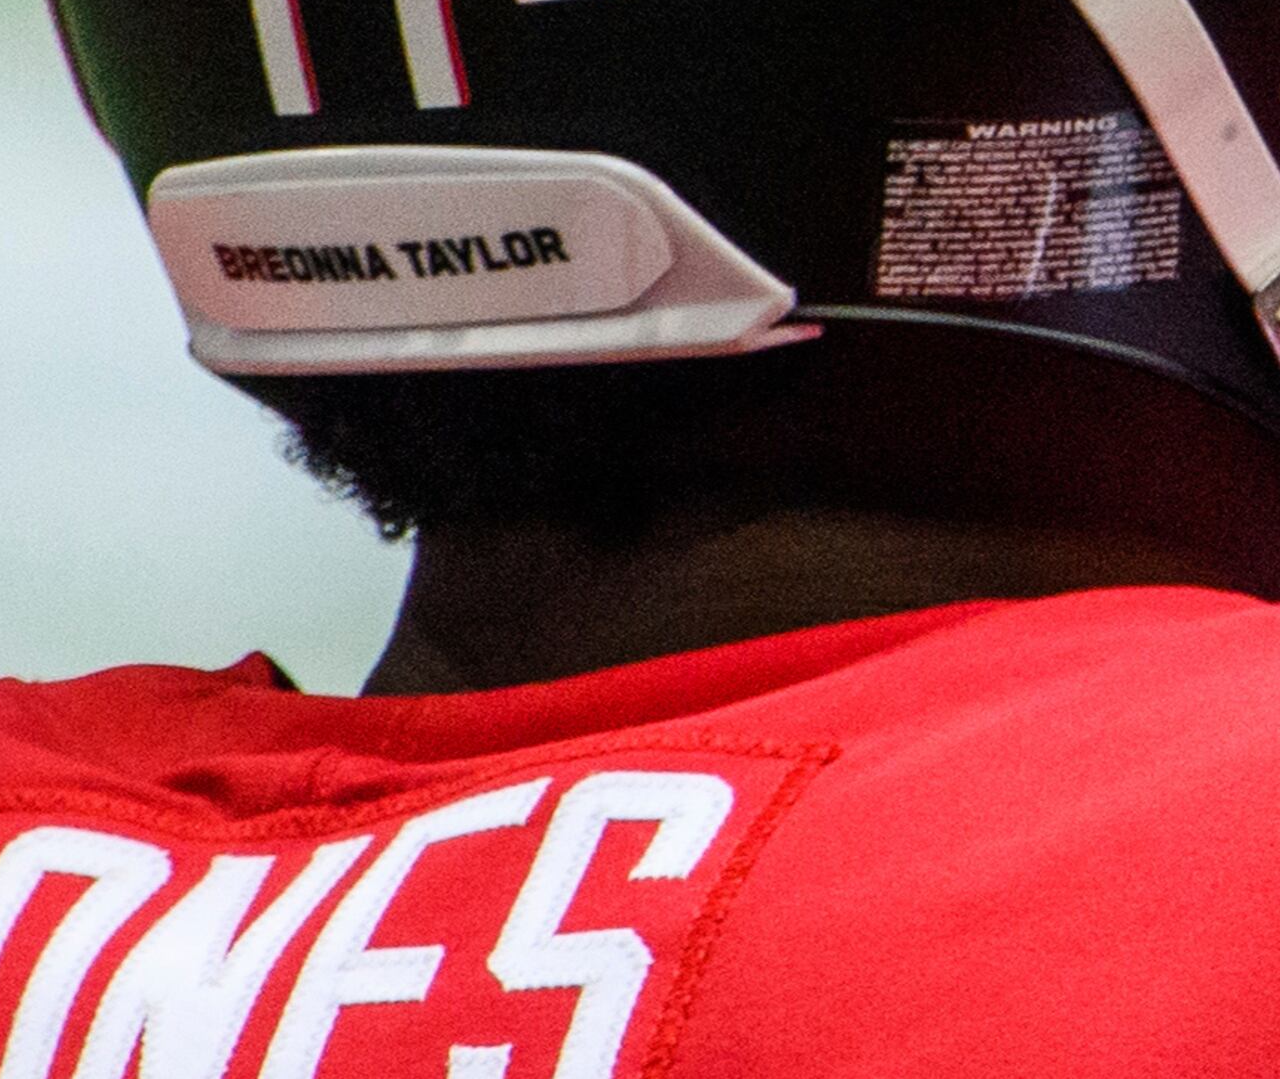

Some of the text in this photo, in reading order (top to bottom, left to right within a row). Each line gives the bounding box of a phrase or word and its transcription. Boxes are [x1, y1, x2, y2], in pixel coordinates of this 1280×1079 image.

[968, 116, 1119, 139] WARNING
[213, 226, 570, 281] BREONNA TAYLOR
